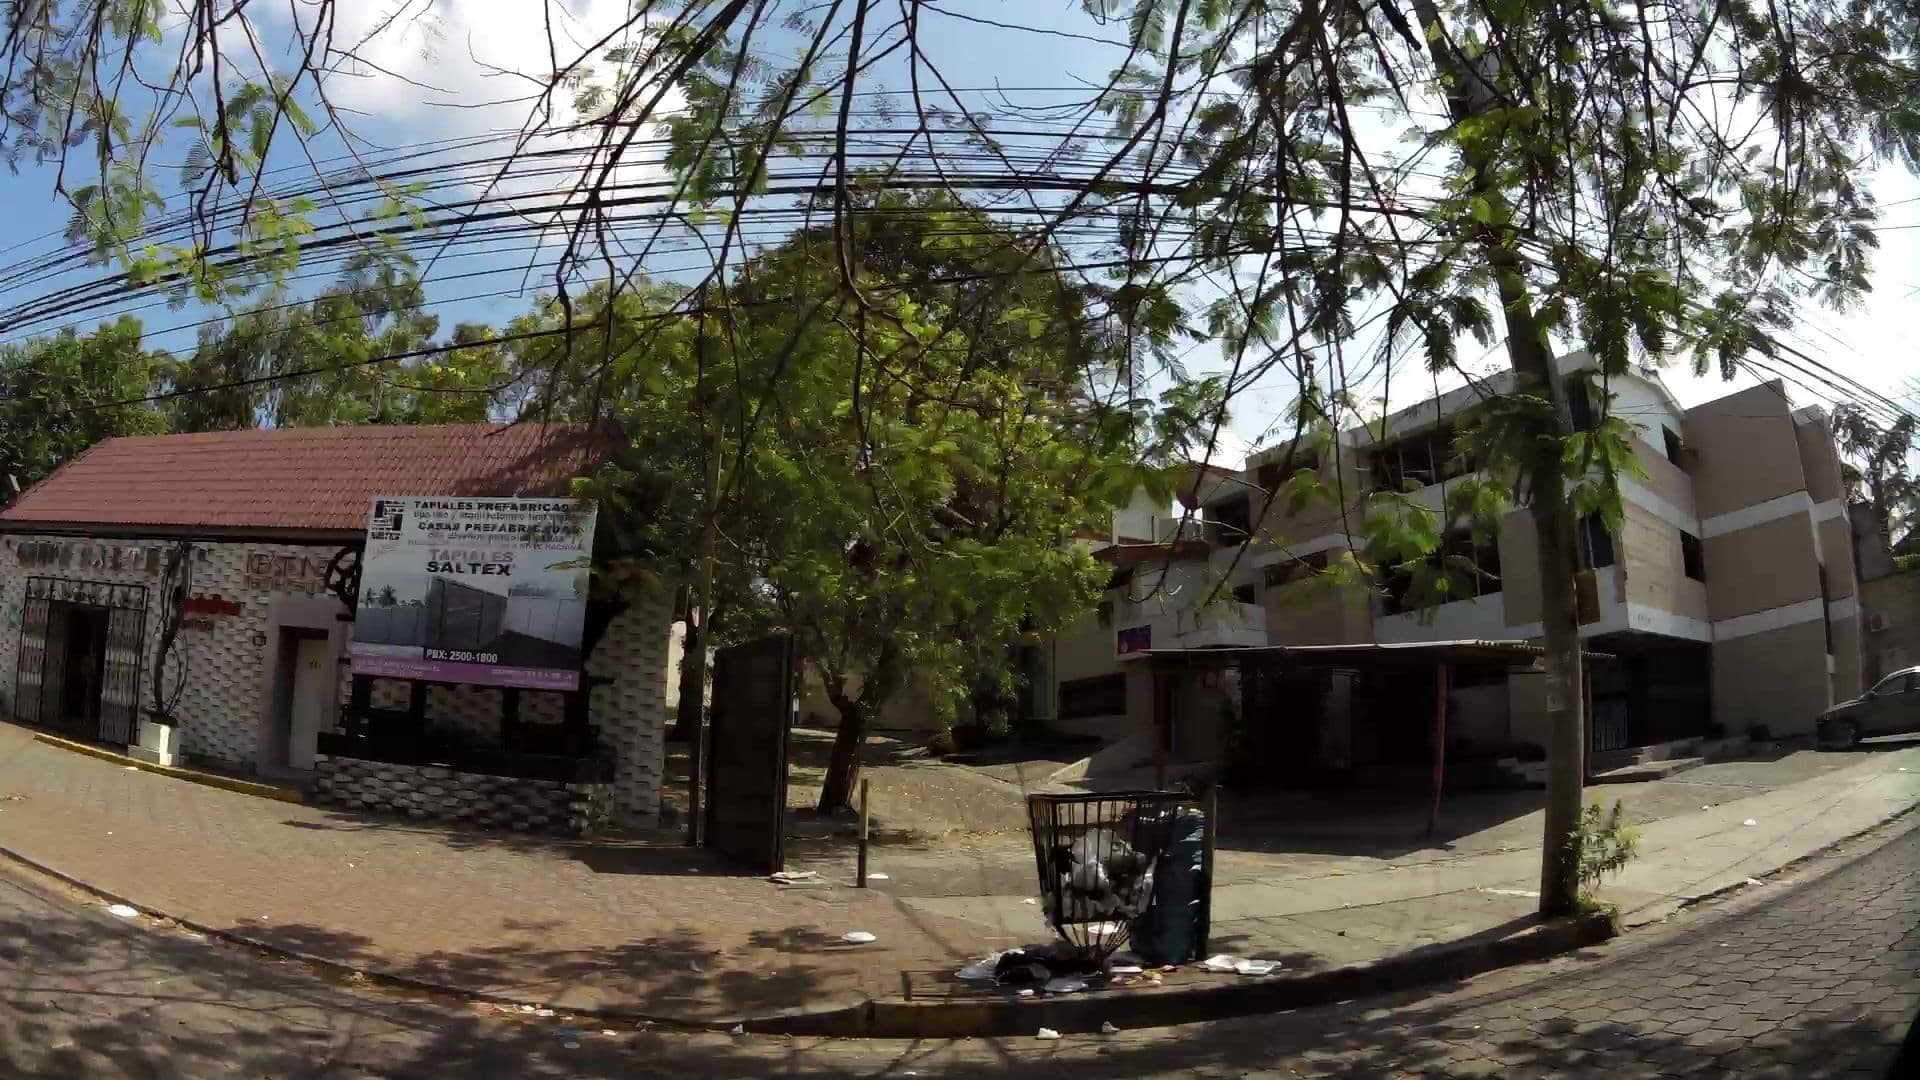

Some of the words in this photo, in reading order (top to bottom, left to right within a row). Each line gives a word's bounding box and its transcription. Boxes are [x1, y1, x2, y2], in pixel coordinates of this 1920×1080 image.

[414, 501, 472, 510] TAPIALES
[478, 501, 570, 513] PREFABRICAD
[418, 521, 460, 531] CASAS
[430, 549, 513, 563] TAPIALES
[426, 561, 512, 577] SALTEX
